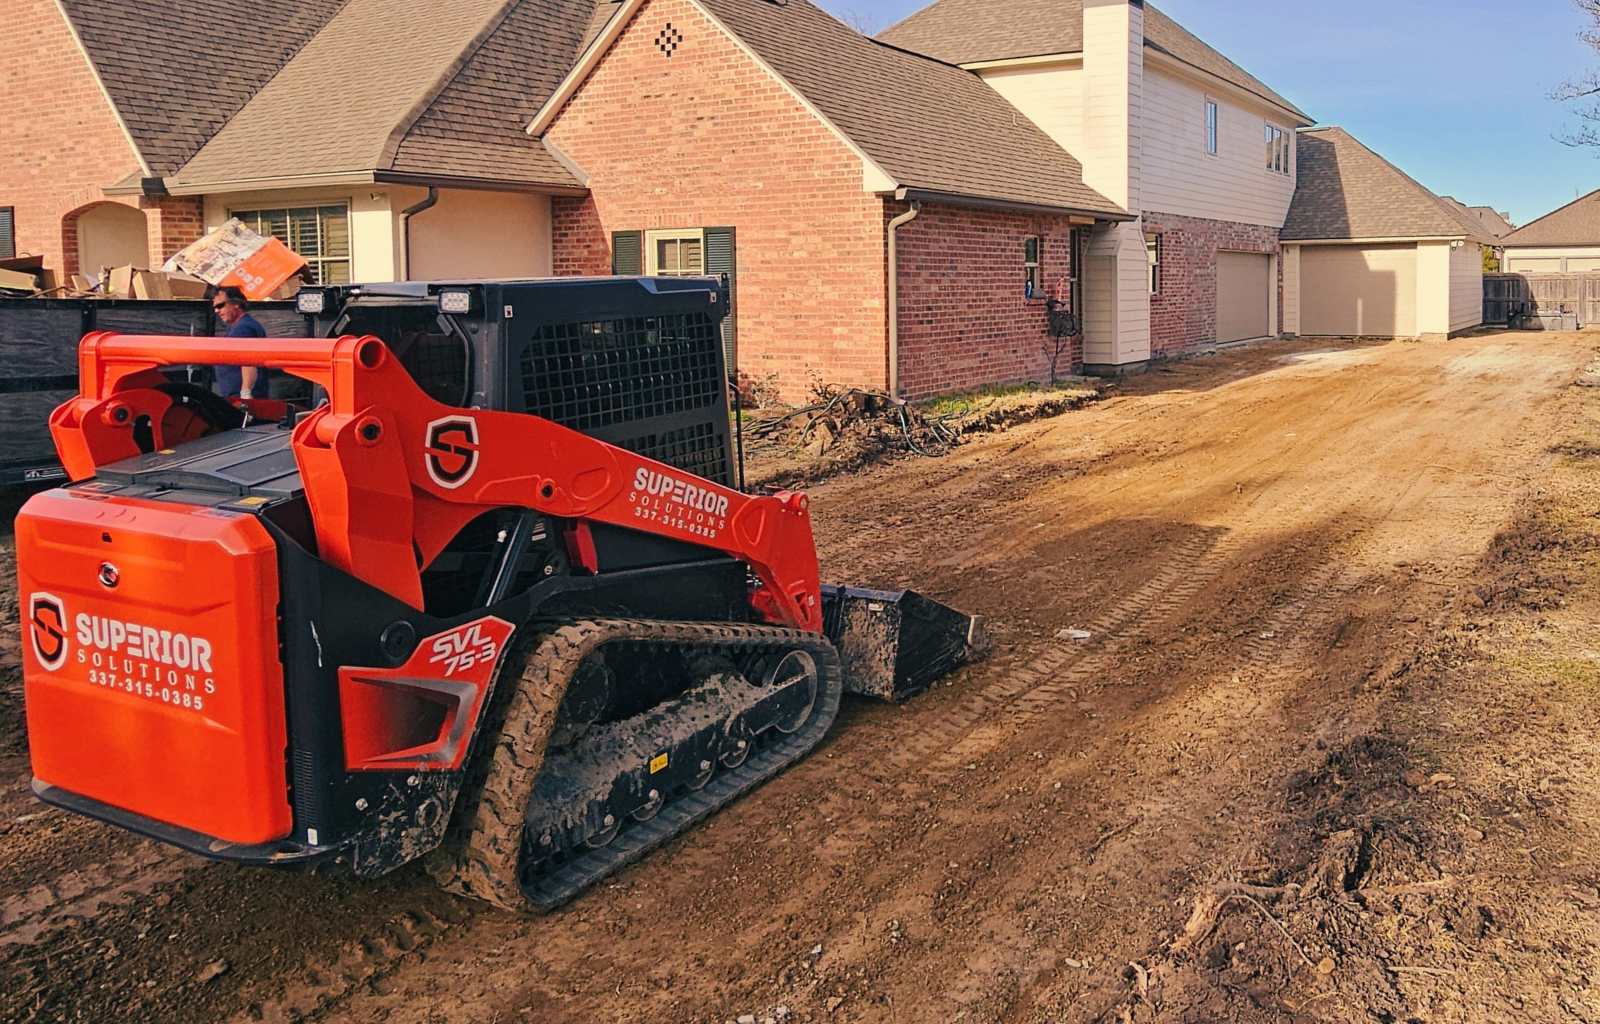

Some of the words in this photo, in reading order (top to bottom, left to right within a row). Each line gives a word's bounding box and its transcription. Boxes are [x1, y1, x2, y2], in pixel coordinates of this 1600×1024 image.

[629, 491, 725, 530] SOLUTIONS
[634, 467, 728, 518] SUPERIOR
[635, 506, 716, 538] 337-315-0385
[76, 613, 213, 673] SUPERIOR
[429, 624, 492, 663] SVL
[444, 642, 496, 677] 75-3
[78, 649, 215, 694] SOLUTIONS
[89, 669, 203, 710] 337-315-0385
